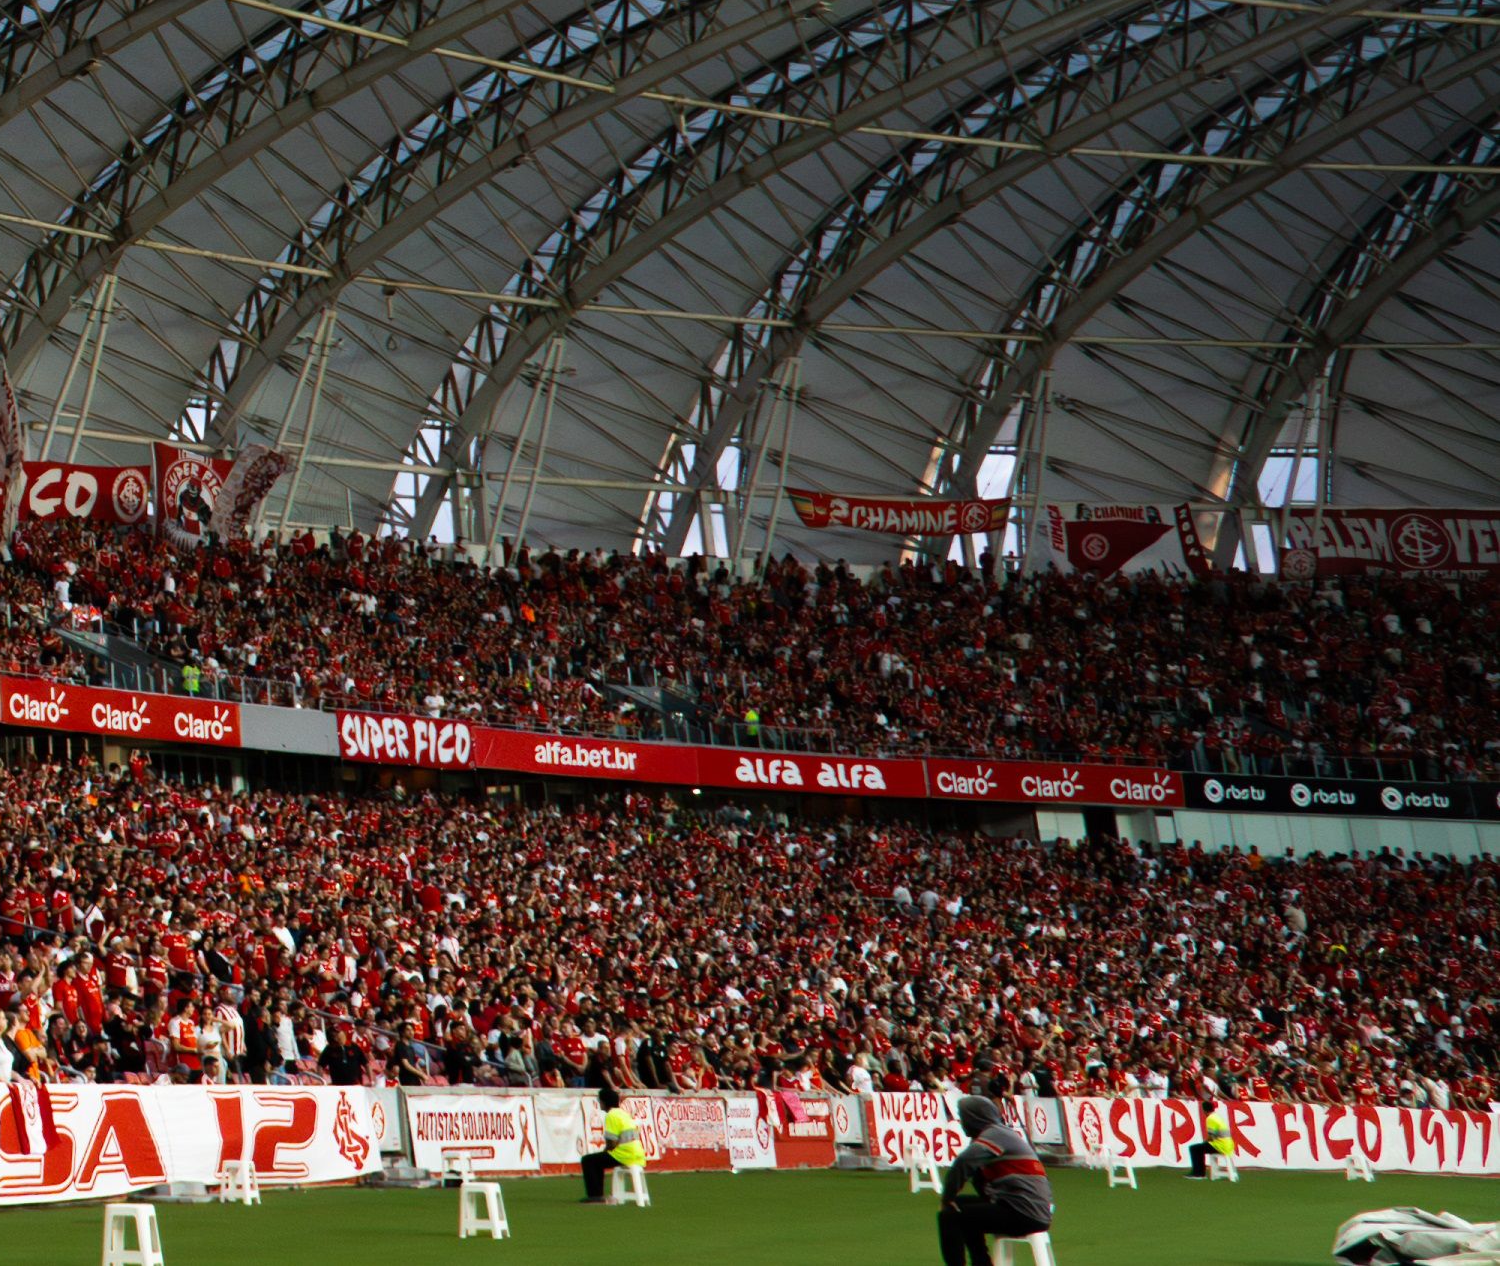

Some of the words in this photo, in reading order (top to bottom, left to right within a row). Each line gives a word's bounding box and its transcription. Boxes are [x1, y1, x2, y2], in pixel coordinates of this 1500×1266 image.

[9, 690, 63, 724] Claro
[91, 700, 145, 733] Claro
[174, 710, 227, 742] Claro
[340, 712, 411, 761] SUPER
[414, 719, 471, 765] FICO
[534, 740, 637, 771] alfa.bet.br
[735, 757, 804, 786] alfa
[816, 762, 887, 790] alfa
[936, 769, 991, 795] Claro
[1020, 773, 1077, 800] Claro
[1109, 777, 1167, 802] Claro
[207, 1089, 319, 1179] 12
[416, 1111, 460, 1142] AUTISTAS
[1271, 1103, 1384, 1165] FICO
[1398, 1106, 1493, 1171] 1977
